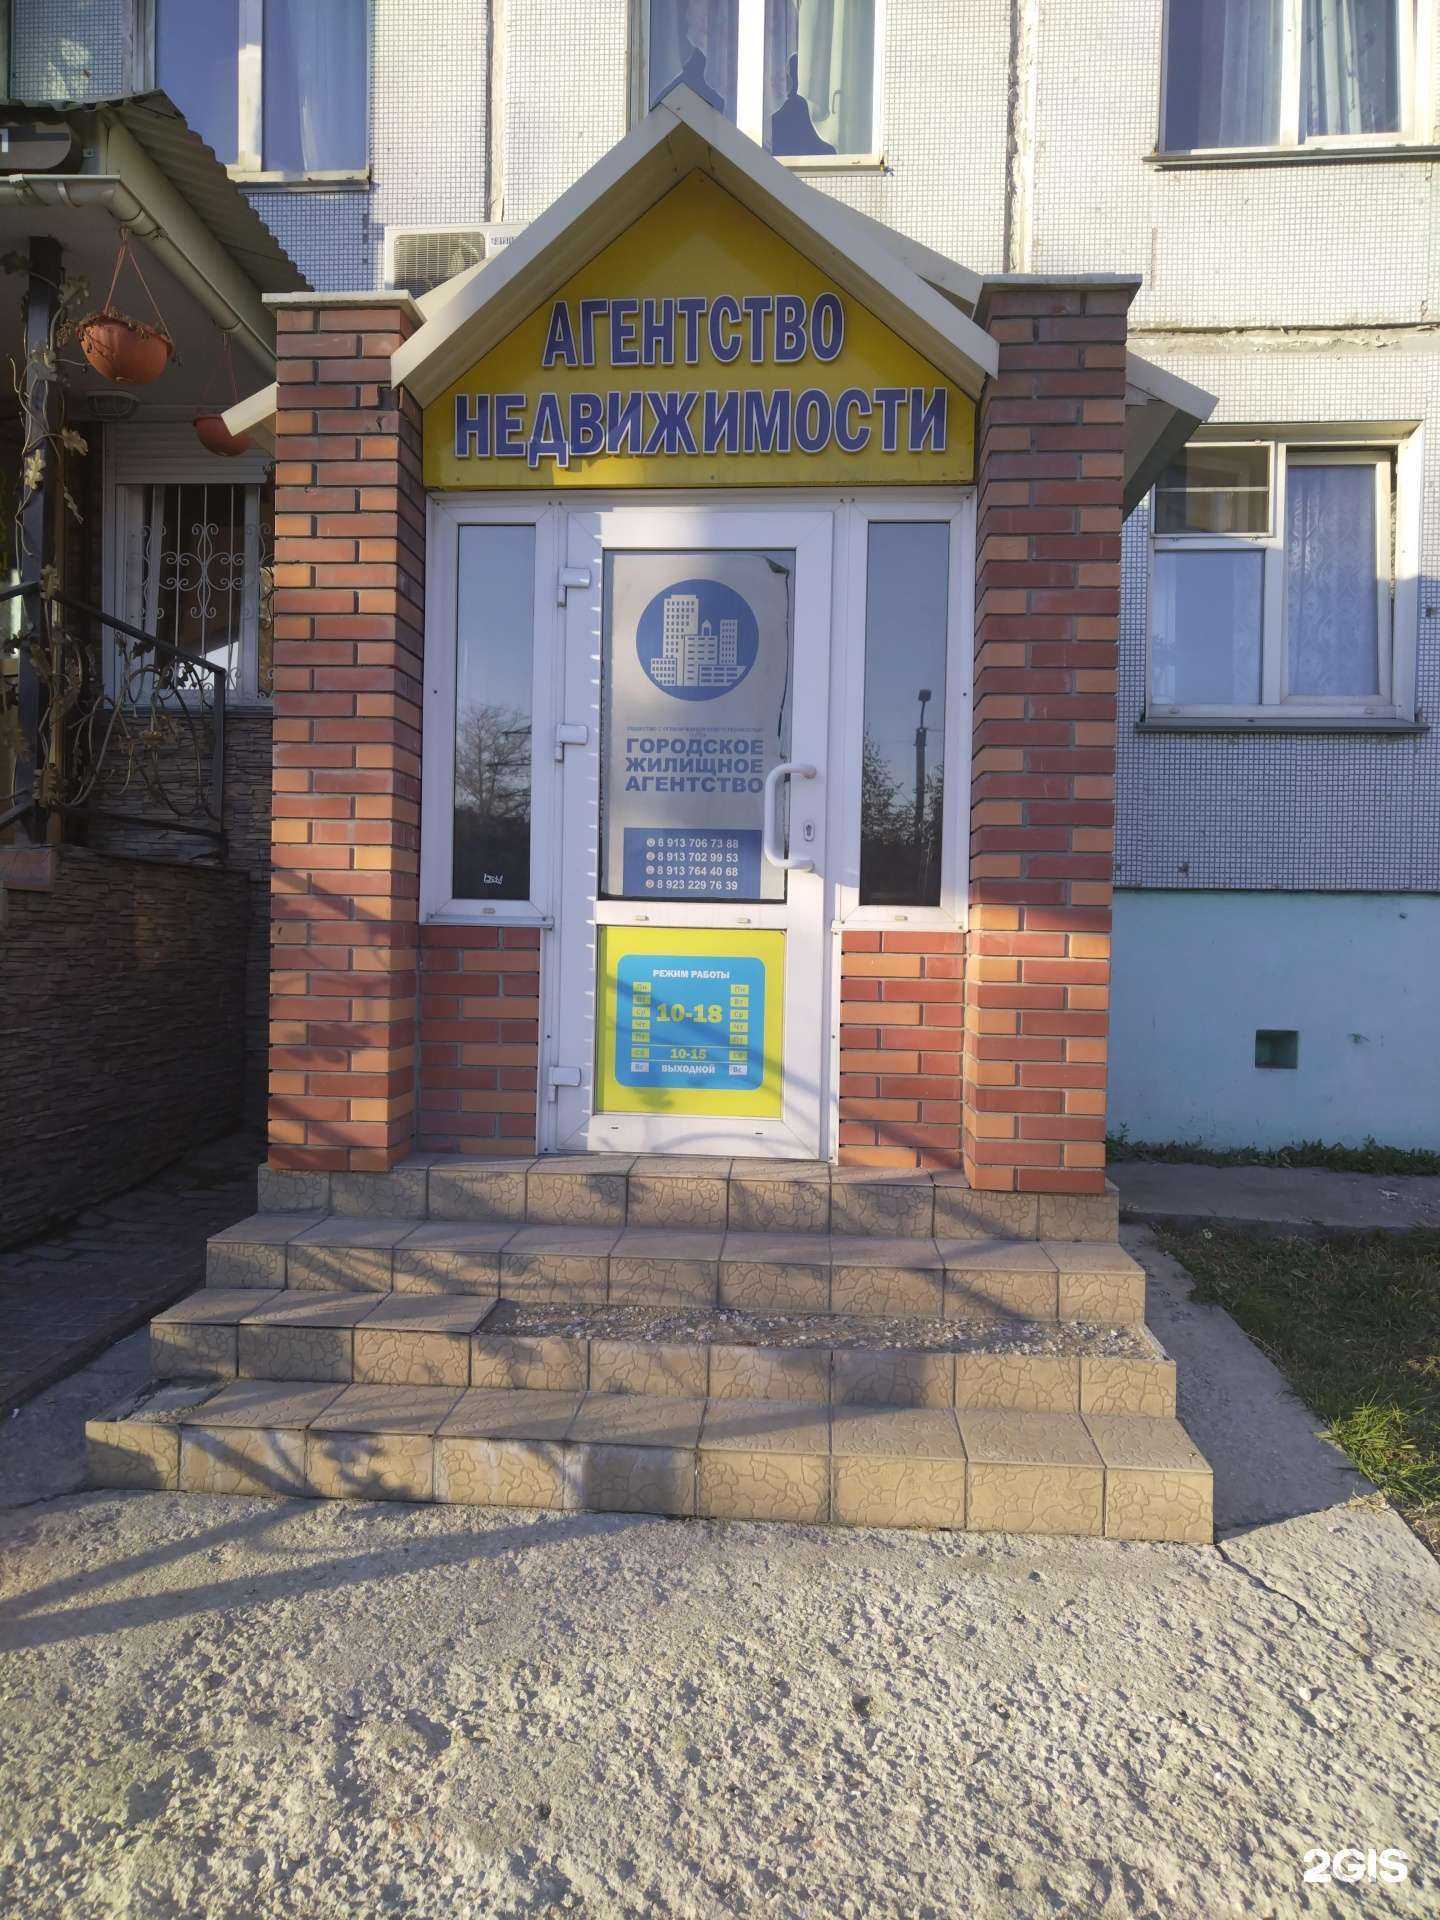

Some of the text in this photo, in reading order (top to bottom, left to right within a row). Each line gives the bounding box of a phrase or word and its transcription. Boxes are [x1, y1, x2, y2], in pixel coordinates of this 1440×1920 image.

[541, 292, 845, 368] АГЕНТСТВО
[453, 386, 949, 469] НЕДВИЖИМОСТИ
[626, 738, 764, 757] ГОРОДСКОЕ
[625, 757, 764, 776] ЖИЛИЩНОЕ
[625, 776, 764, 793] АГЕНТСТВО
[658, 838, 664, 848] 8
[667, 838, 686, 848] 913
[689, 838, 708, 848] 706
[657, 852, 738, 863] 8 913 702 99 53
[657, 865, 664, 875] 8
[666, 866, 686, 876] 913
[688, 866, 707, 876] 764
[710, 866, 722, 876] 40
[657, 879, 663, 889] 8
[666, 880, 685, 889] 923
[709, 881, 722, 890] 76
[652, 969, 730, 979] РЕЖИМ РАБОТЫ
[656, 1003, 723, 1023] 10-18
[670, 1048, 707, 1060] 10-15
[661, 1063, 716, 1075] ВЫХОДНОЙ
